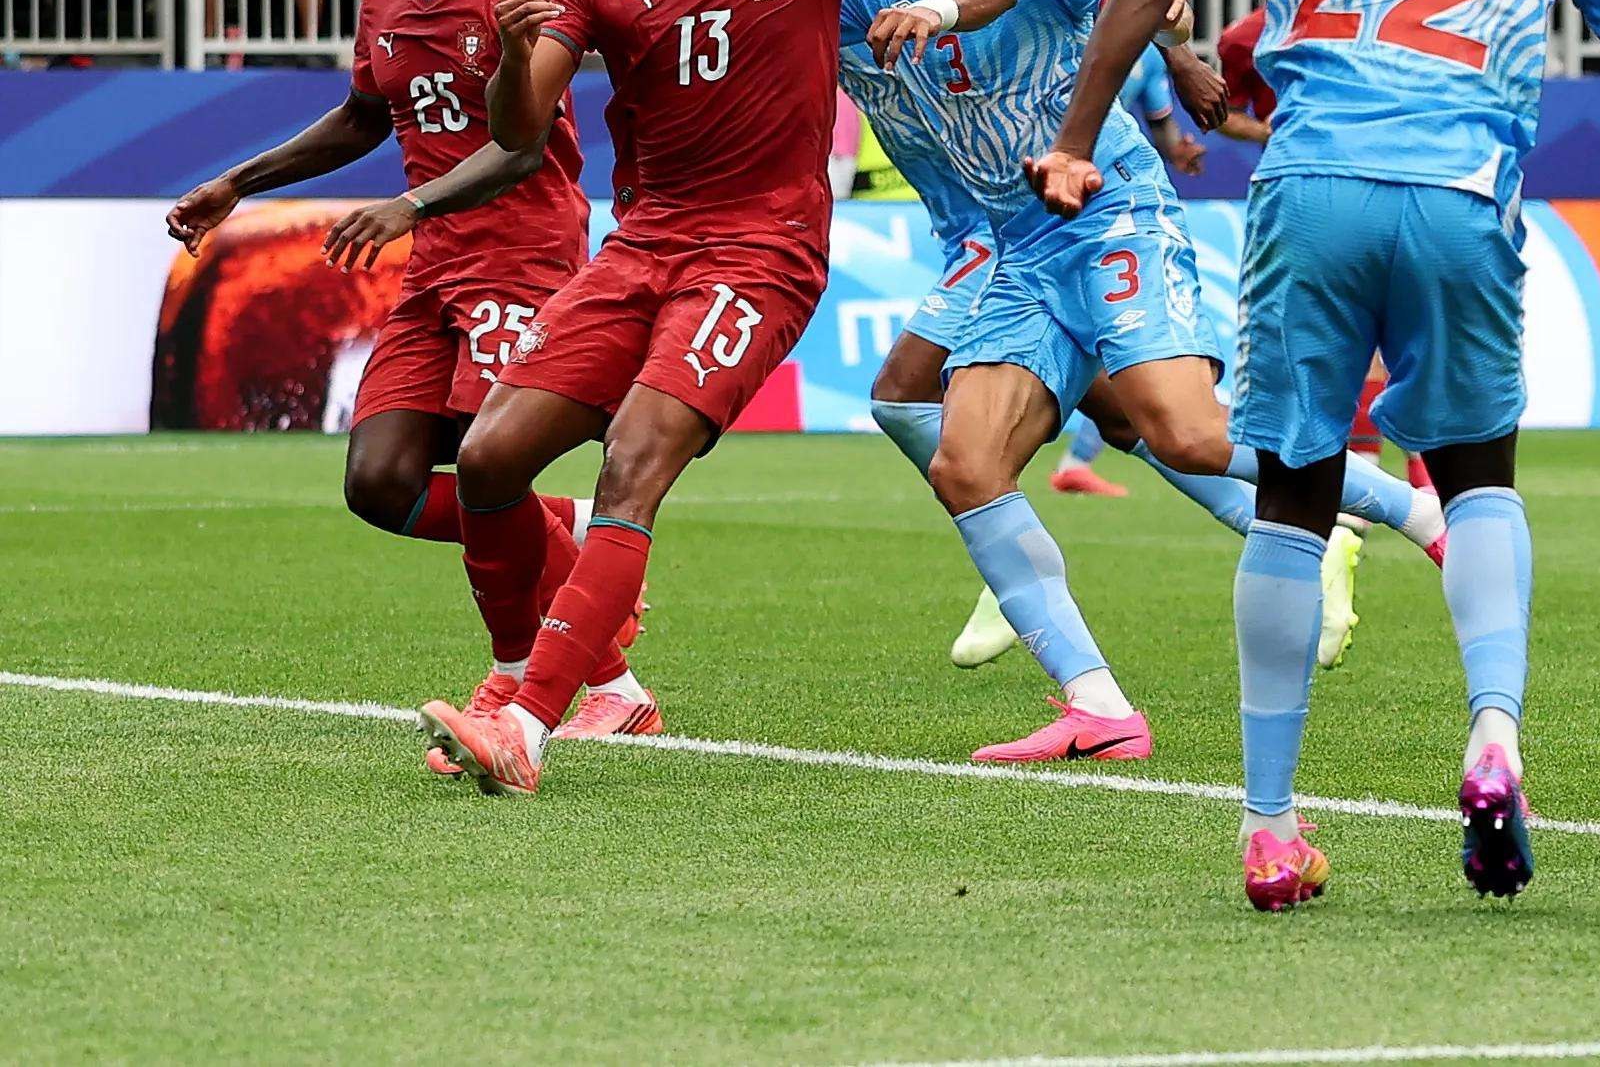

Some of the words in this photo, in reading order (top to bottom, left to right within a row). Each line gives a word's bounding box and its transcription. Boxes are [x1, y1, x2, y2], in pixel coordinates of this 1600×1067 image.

[674, 8, 732, 86] 13
[935, 33, 973, 95] 3
[409, 71, 470, 134] 25
[943, 239, 992, 289] 7
[1099, 248, 1140, 304] 3
[469, 299, 535, 366] 25
[690, 283, 764, 368] 13
